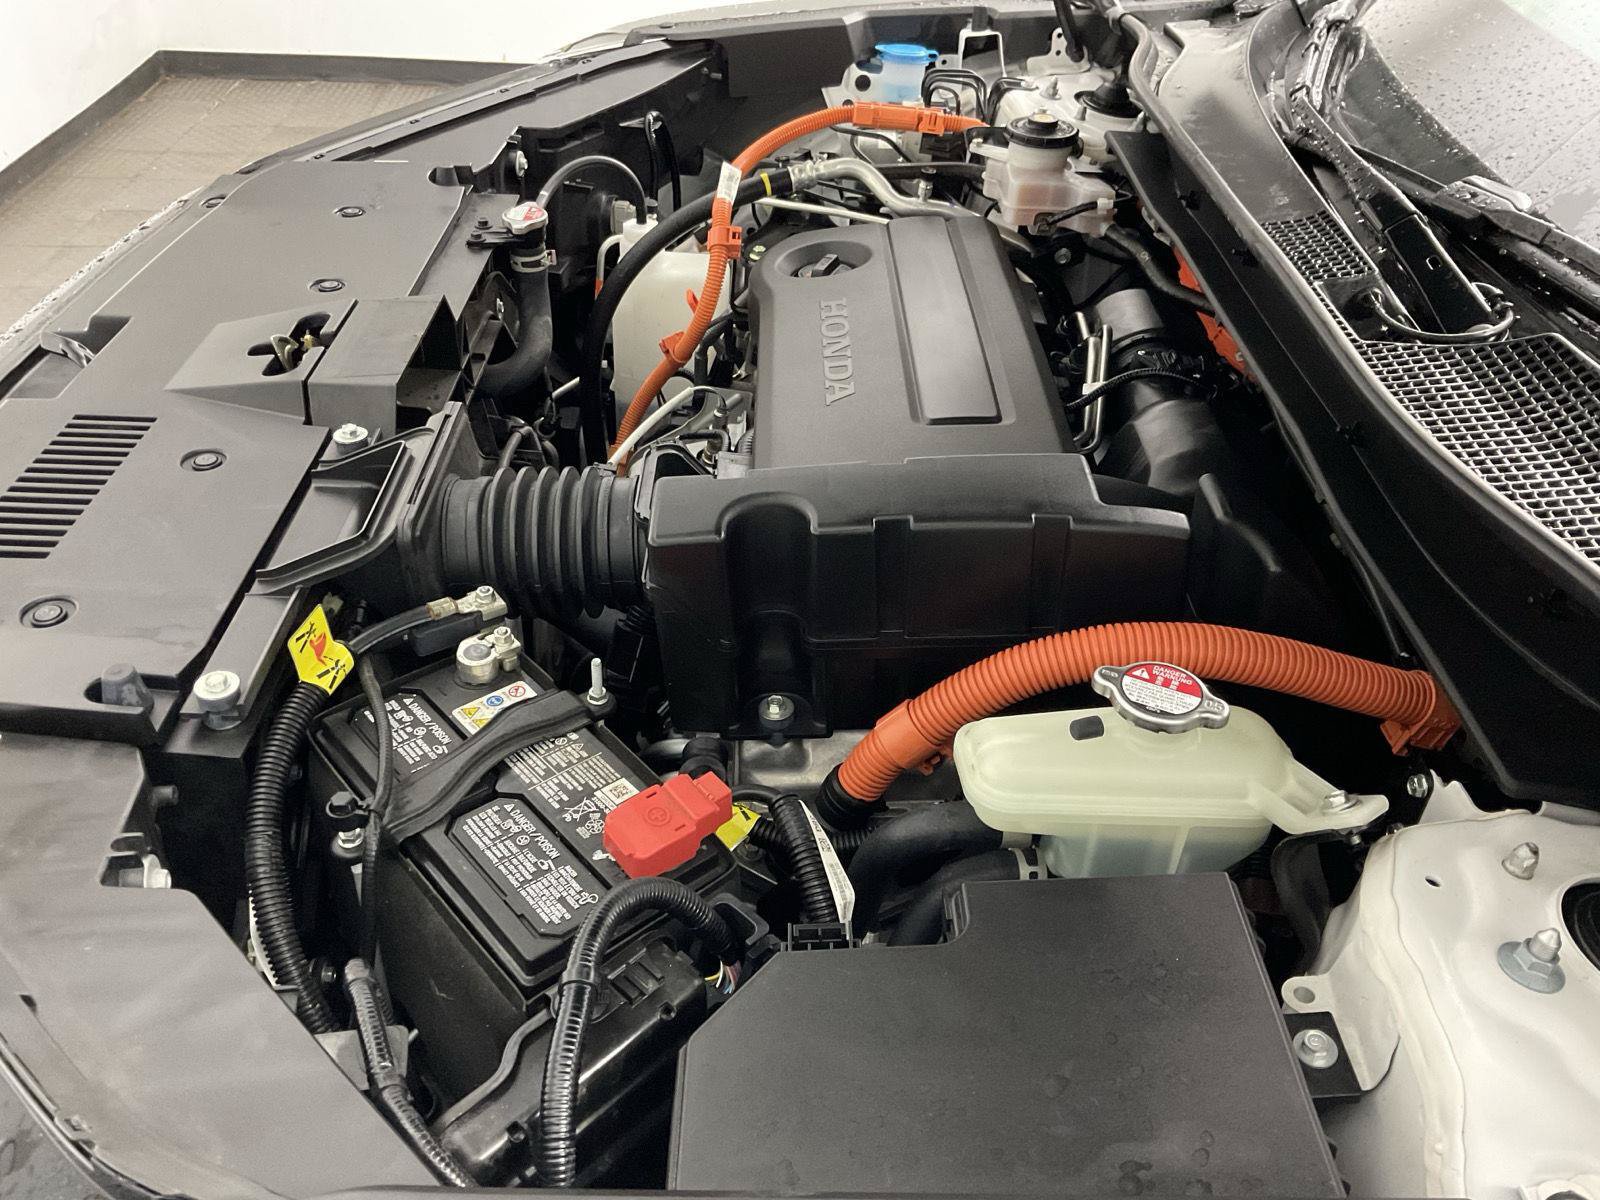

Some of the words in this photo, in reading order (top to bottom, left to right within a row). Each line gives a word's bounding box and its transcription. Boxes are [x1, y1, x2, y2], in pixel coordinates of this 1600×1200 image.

[820, 298, 856, 407] HONDA
[1152, 669, 1193, 685] WARNUNG
[1153, 665, 1187, 679] DANGER
